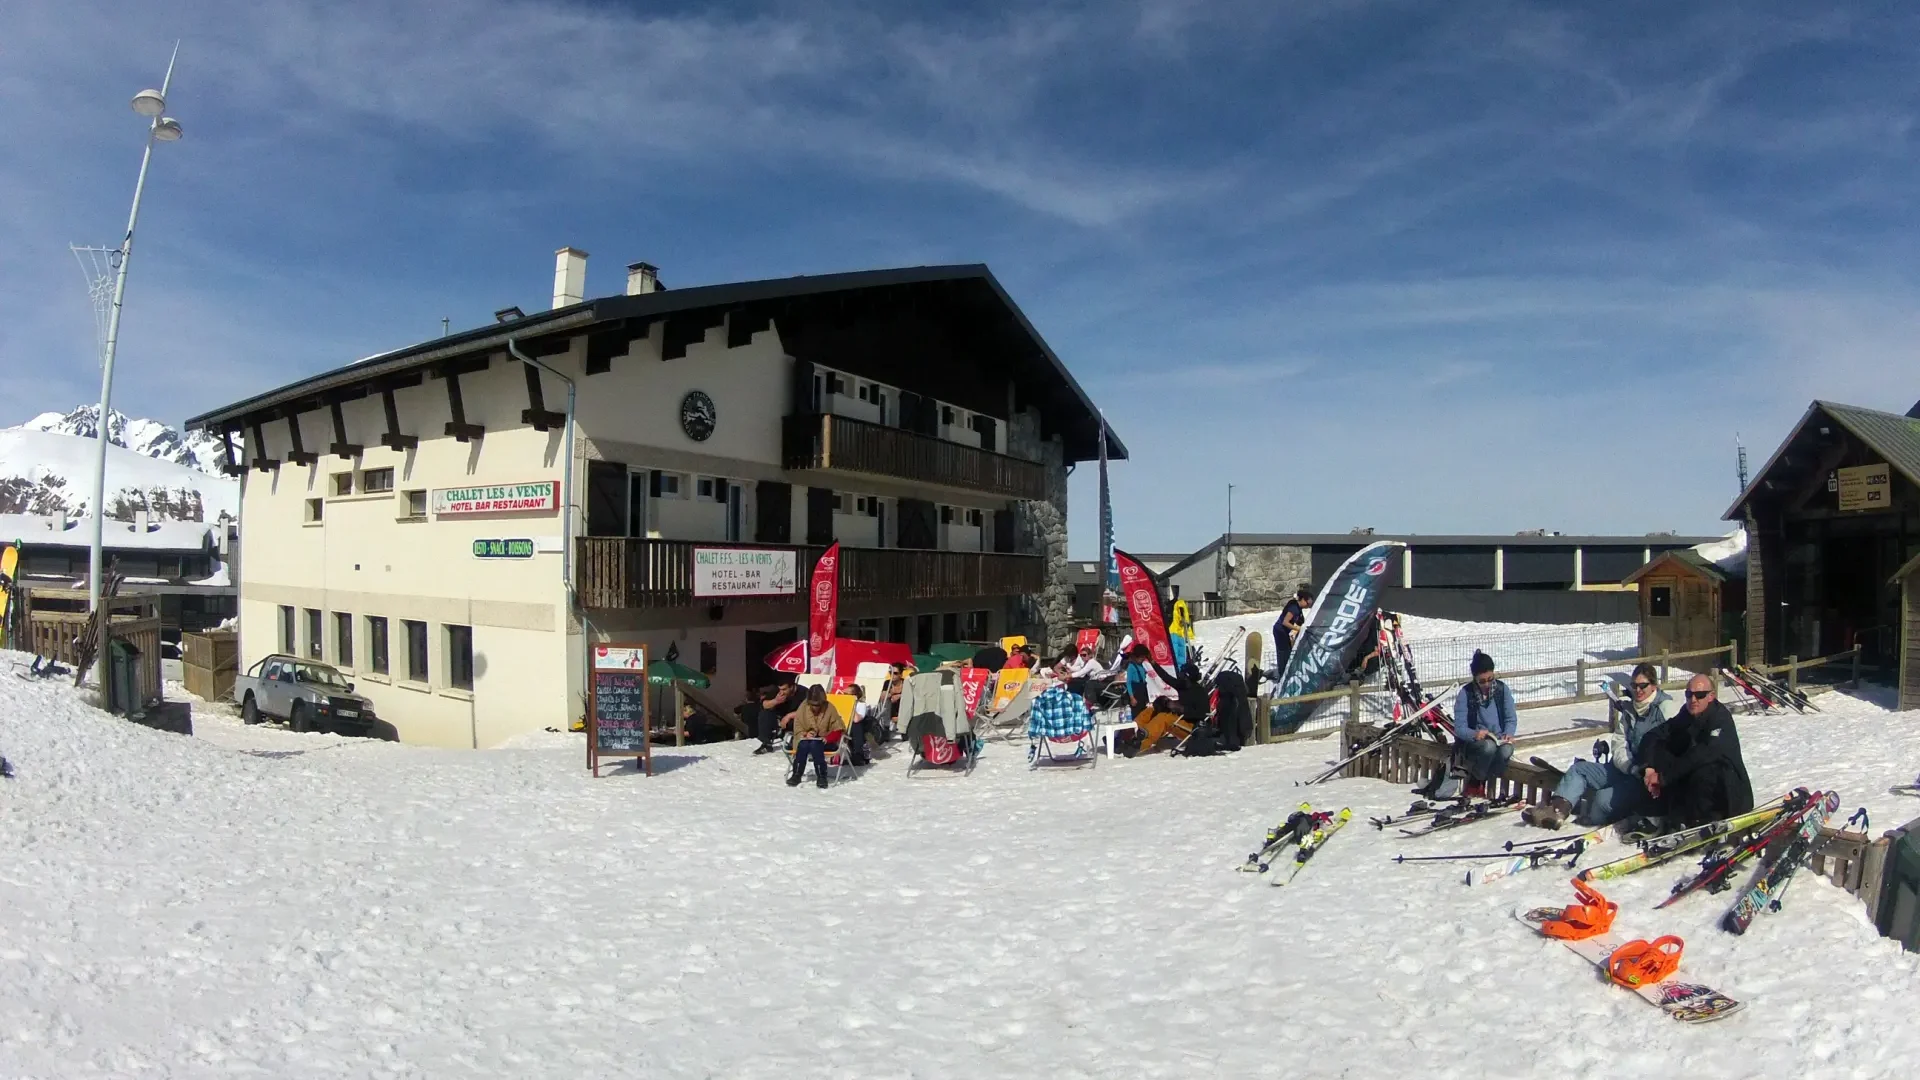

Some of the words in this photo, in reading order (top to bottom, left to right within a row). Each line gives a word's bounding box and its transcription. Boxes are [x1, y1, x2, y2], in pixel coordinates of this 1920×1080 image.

[446, 489, 484, 501] CHALET
[487, 487, 505, 499] LES
[507, 487, 514, 499] 4
[516, 484, 551, 497] VENTS
[450, 501, 473, 511] HOTEL
[475, 501, 491, 510] BAR
[493, 498, 546, 510] RESTAURANT
[696, 552, 718, 565] CHALET
[739, 553, 750, 565] LES
[755, 553, 773, 566] VENTS
[712, 570, 738, 579] HOTEL
[745, 570, 761, 578] BAR
[712, 581, 761, 590] RESTAURANT
